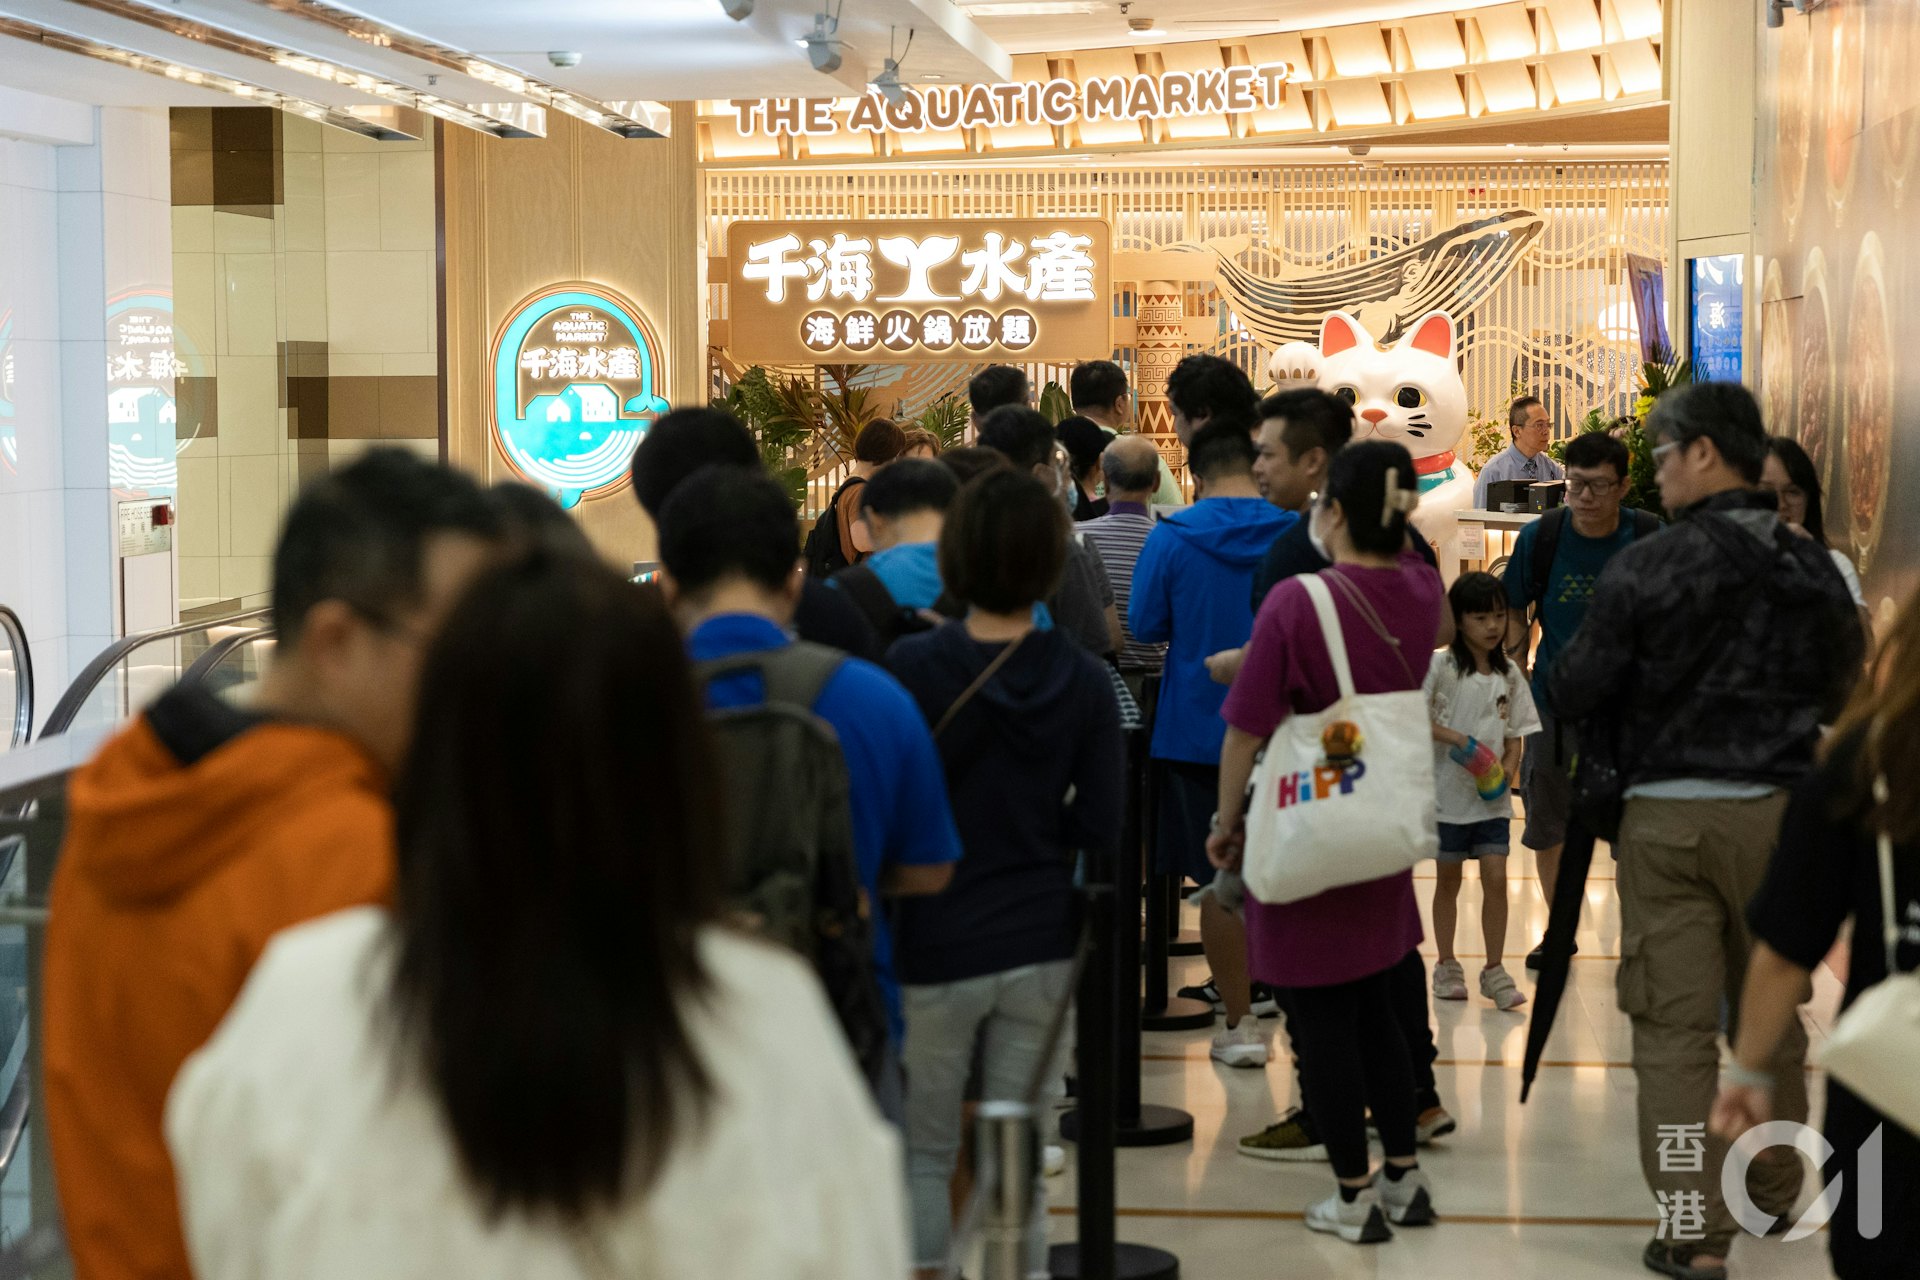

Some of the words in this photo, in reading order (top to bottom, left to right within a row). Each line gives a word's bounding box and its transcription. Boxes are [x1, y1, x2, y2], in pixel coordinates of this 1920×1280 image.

[729, 98, 838, 136] THE
[848, 78, 1078, 134] AQUATIC
[1083, 62, 1290, 122] MARKET
[552, 321, 607, 331] AQUATIC
[569, 312, 592, 321] THE
[555, 332, 607, 342] MARKET
[805, 315, 1031, 345] 海鮮火鍋放題
[521, 347, 639, 378] 千海水產
